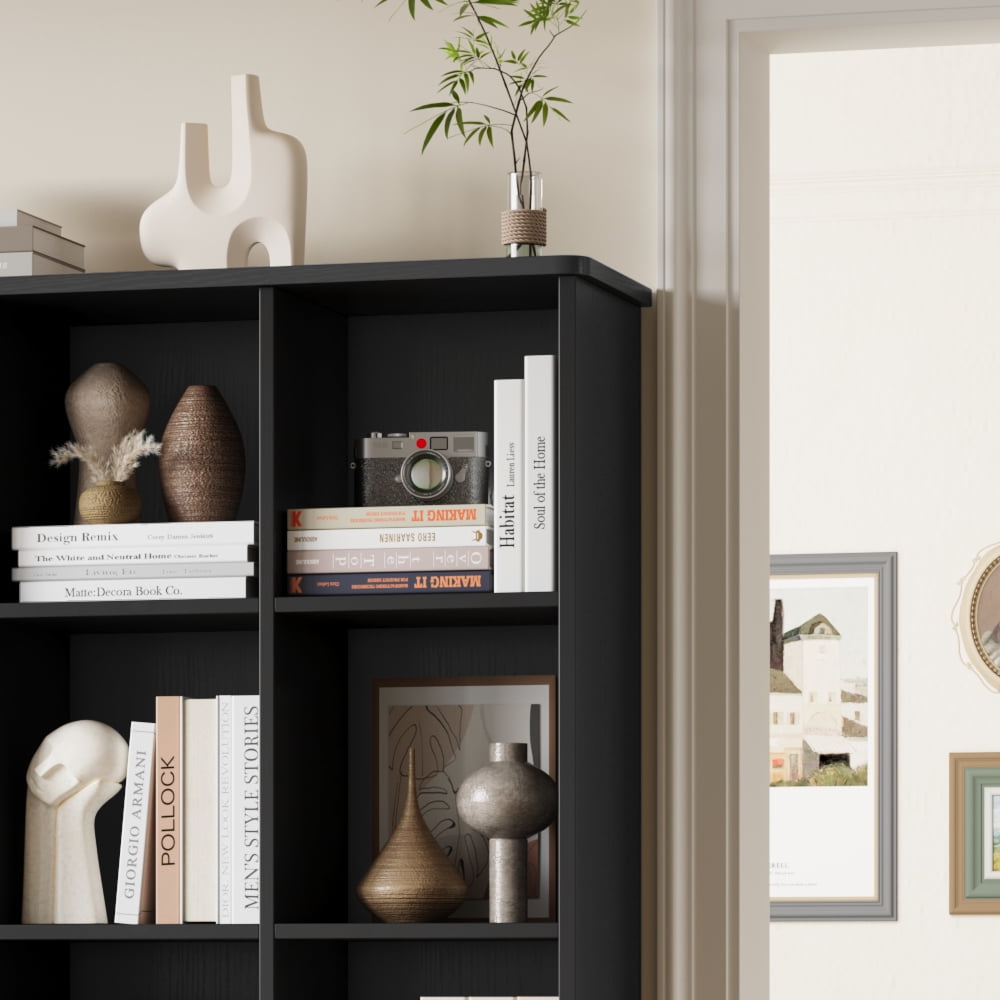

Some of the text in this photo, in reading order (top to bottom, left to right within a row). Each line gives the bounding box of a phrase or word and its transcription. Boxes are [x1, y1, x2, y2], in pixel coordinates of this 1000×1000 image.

[506, 462, 515, 487] Lauren
[533, 436, 546, 530] Soul of the Home
[411, 510, 424, 522] IT
[427, 508, 477, 521] MAKING
[499, 495, 515, 548] Habitat
[37, 533, 77, 545] Design
[82, 532, 119, 542] Remix
[379, 532, 436, 543] EERO SAARINEN
[106, 553, 141, 561] Neutral
[144, 552, 172, 560] Home
[413, 576, 427, 589] IT
[430, 575, 482, 589] MAKING
[135, 585, 163, 596] Book
[165, 585, 183, 596] Co.
[160, 756, 175, 866] POLLOCK
[244, 706, 259, 909] MEN'S STYLE STORIES
[124, 751, 147, 899] GIORGIO ARMANI
